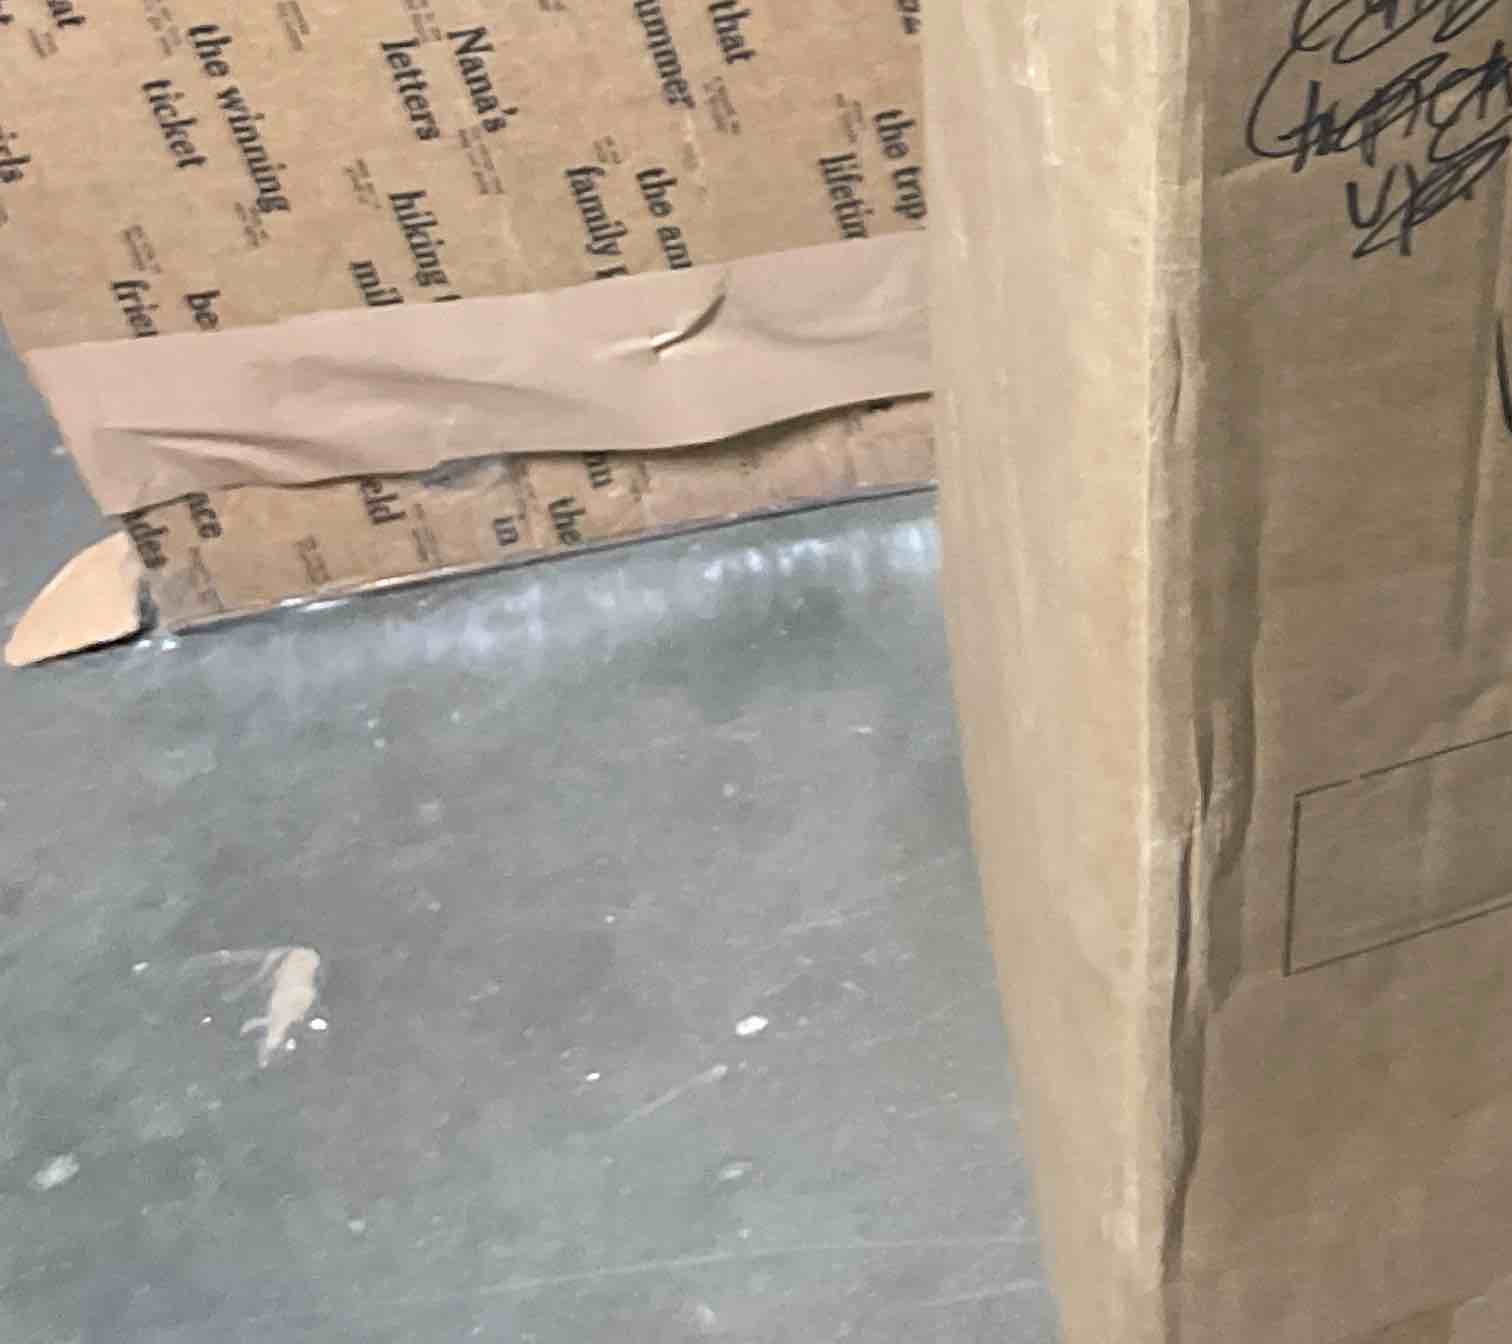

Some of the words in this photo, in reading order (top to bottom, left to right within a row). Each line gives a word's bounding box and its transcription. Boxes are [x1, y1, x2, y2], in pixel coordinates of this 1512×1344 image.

[141, 77, 209, 173] ticket
[186, 23, 231, 80] the
[215, 83, 292, 215] winning
[379, 37, 441, 143] letters
[445, 23, 520, 134] Nana's
[872, 108, 917, 162] the
[387, 189, 449, 289] hiking
[565, 164, 629, 257] family
[634, 166, 679, 219] the
